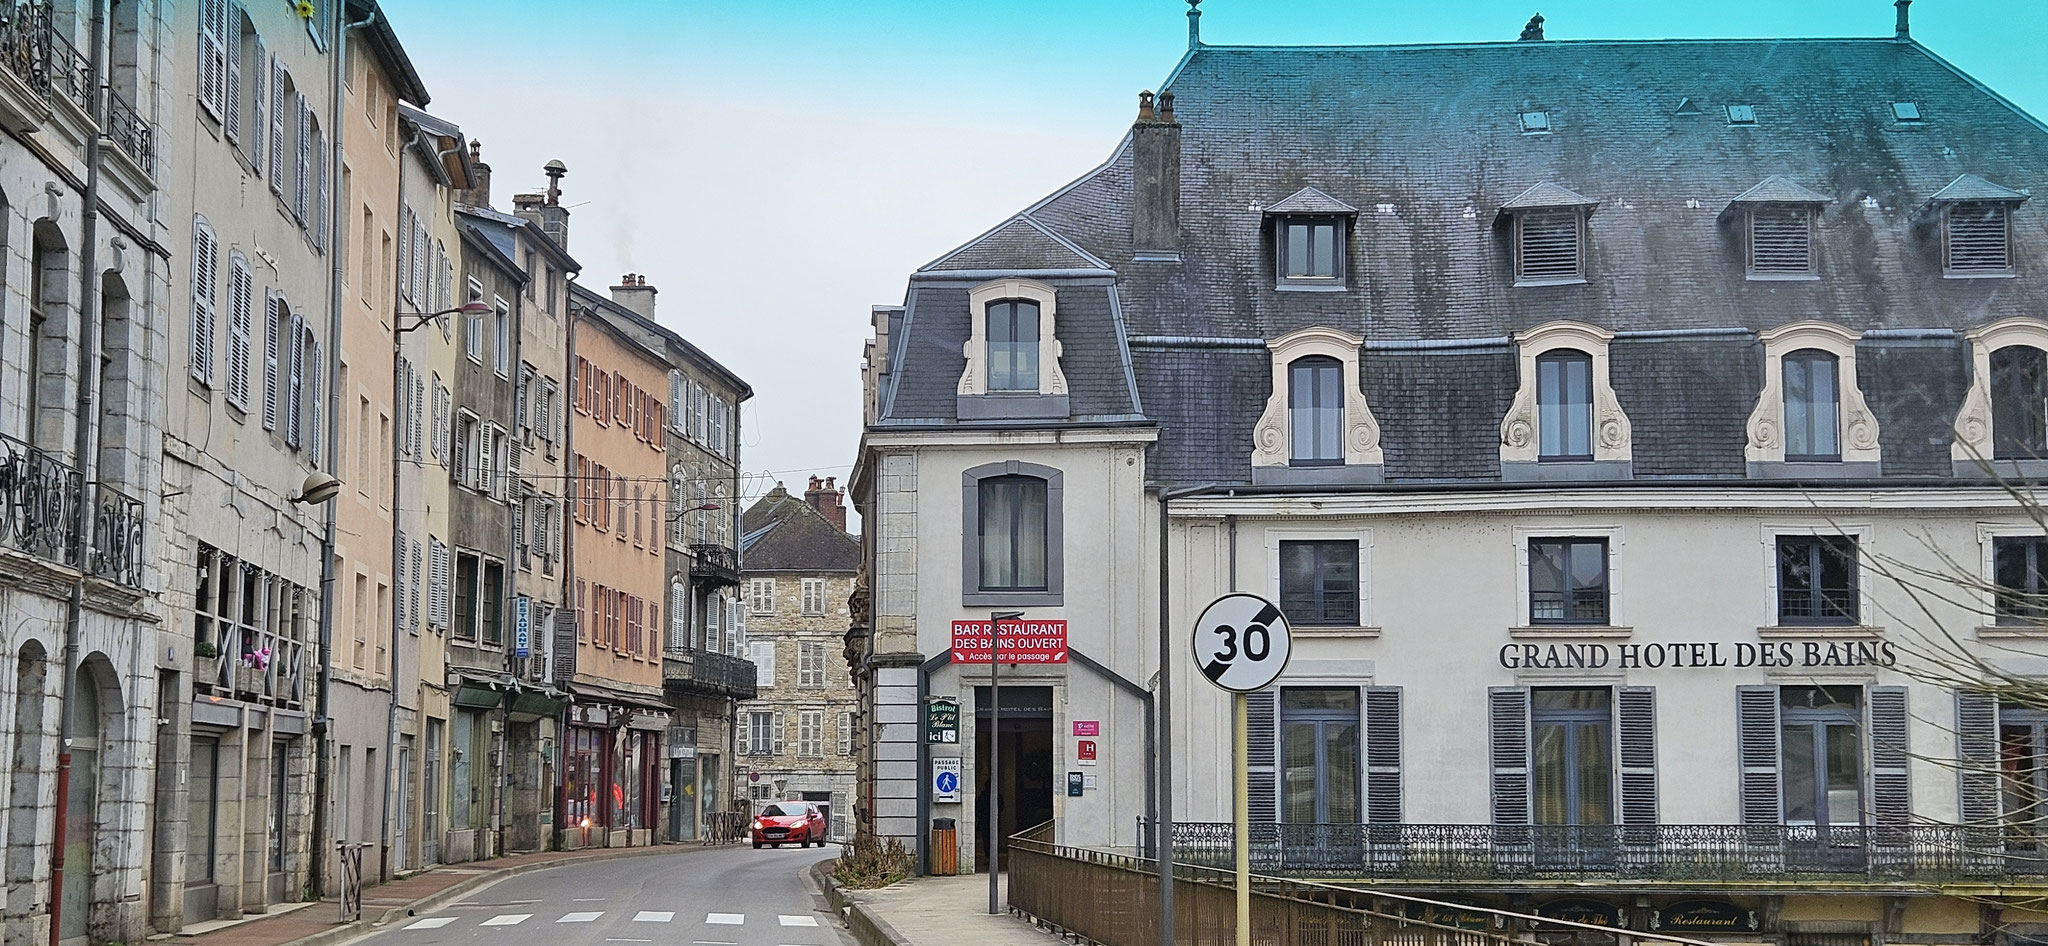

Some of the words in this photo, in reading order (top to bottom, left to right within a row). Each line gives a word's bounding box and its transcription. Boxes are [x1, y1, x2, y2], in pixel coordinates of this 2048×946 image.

[518, 598, 527, 647] RESTAURANT
[954, 624, 980, 635] BAR
[955, 639, 977, 648] DES
[1017, 638, 1063, 648] OUVERT
[1213, 624, 1270, 662] 30
[969, 652, 993, 660] Accès
[1017, 653, 1050, 661] passage
[1499, 643, 1609, 669] GRAND
[1617, 642, 1727, 668] HOTEL
[1734, 642, 1794, 667] DES
[1801, 641, 1897, 667] BAINS
[929, 732, 941, 741] ici
[1086, 744, 1094, 752] H
[1670, 914, 1738, 926] Restaurant
